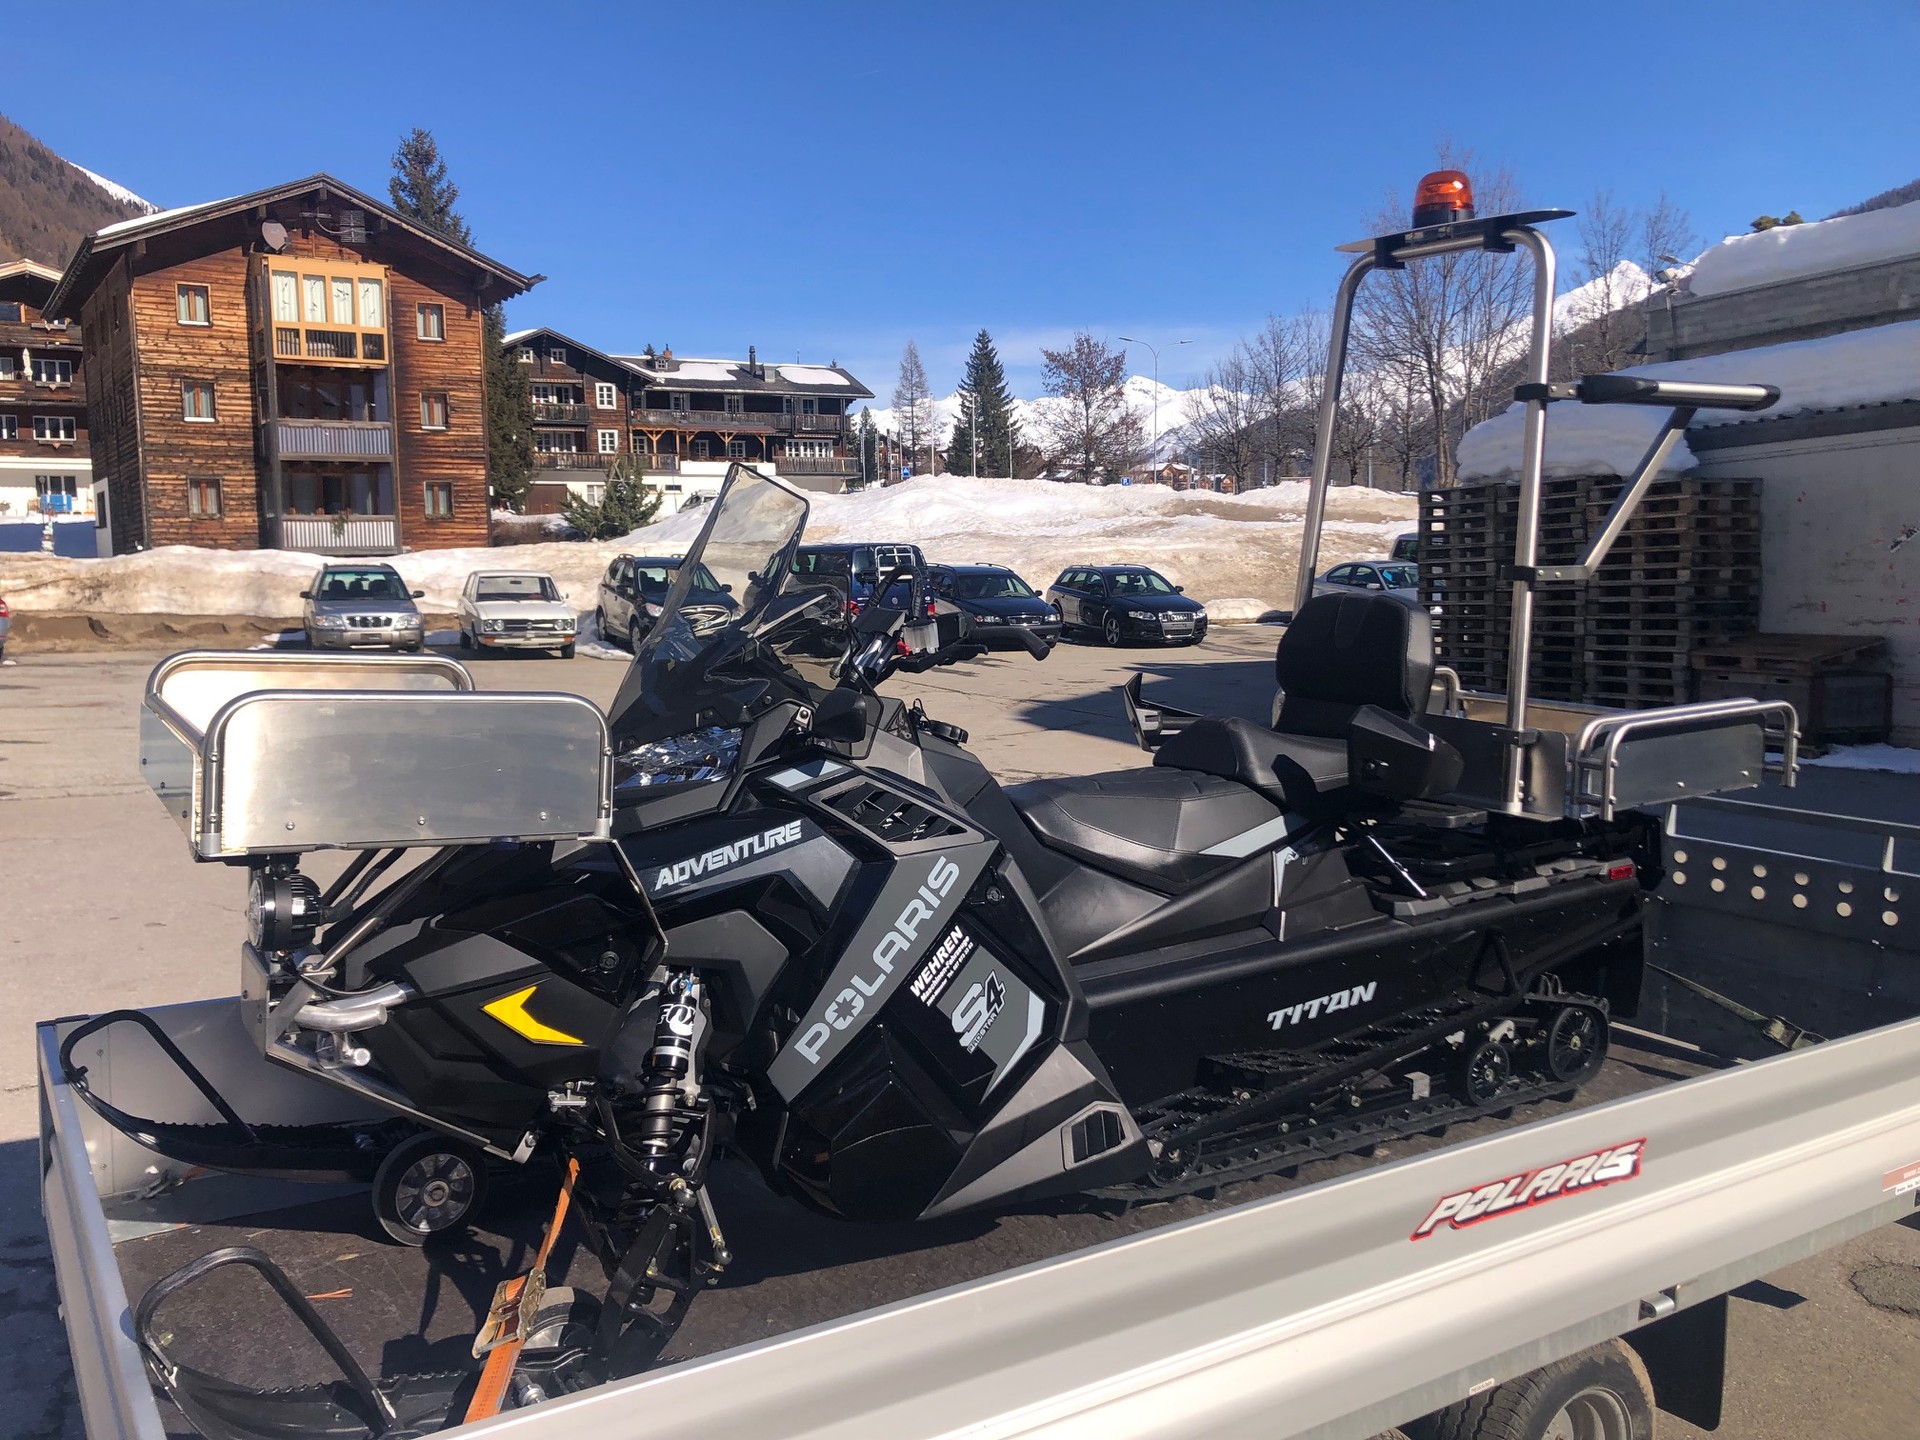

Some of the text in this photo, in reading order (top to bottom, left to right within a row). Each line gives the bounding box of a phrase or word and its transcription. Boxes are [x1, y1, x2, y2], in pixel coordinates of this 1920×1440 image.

[654, 819, 802, 891] ADVENTURE
[794, 855, 960, 1065] POLARIS
[909, 925, 963, 998] WEHREN
[920, 936, 970, 1002] Maschinen-Fahrzeuge
[951, 969, 1006, 1047] S4
[966, 1012, 998, 1054] PROSTAR
[1266, 981, 1378, 1031] TITAN
[1413, 1140, 1643, 1237] POLARIS
